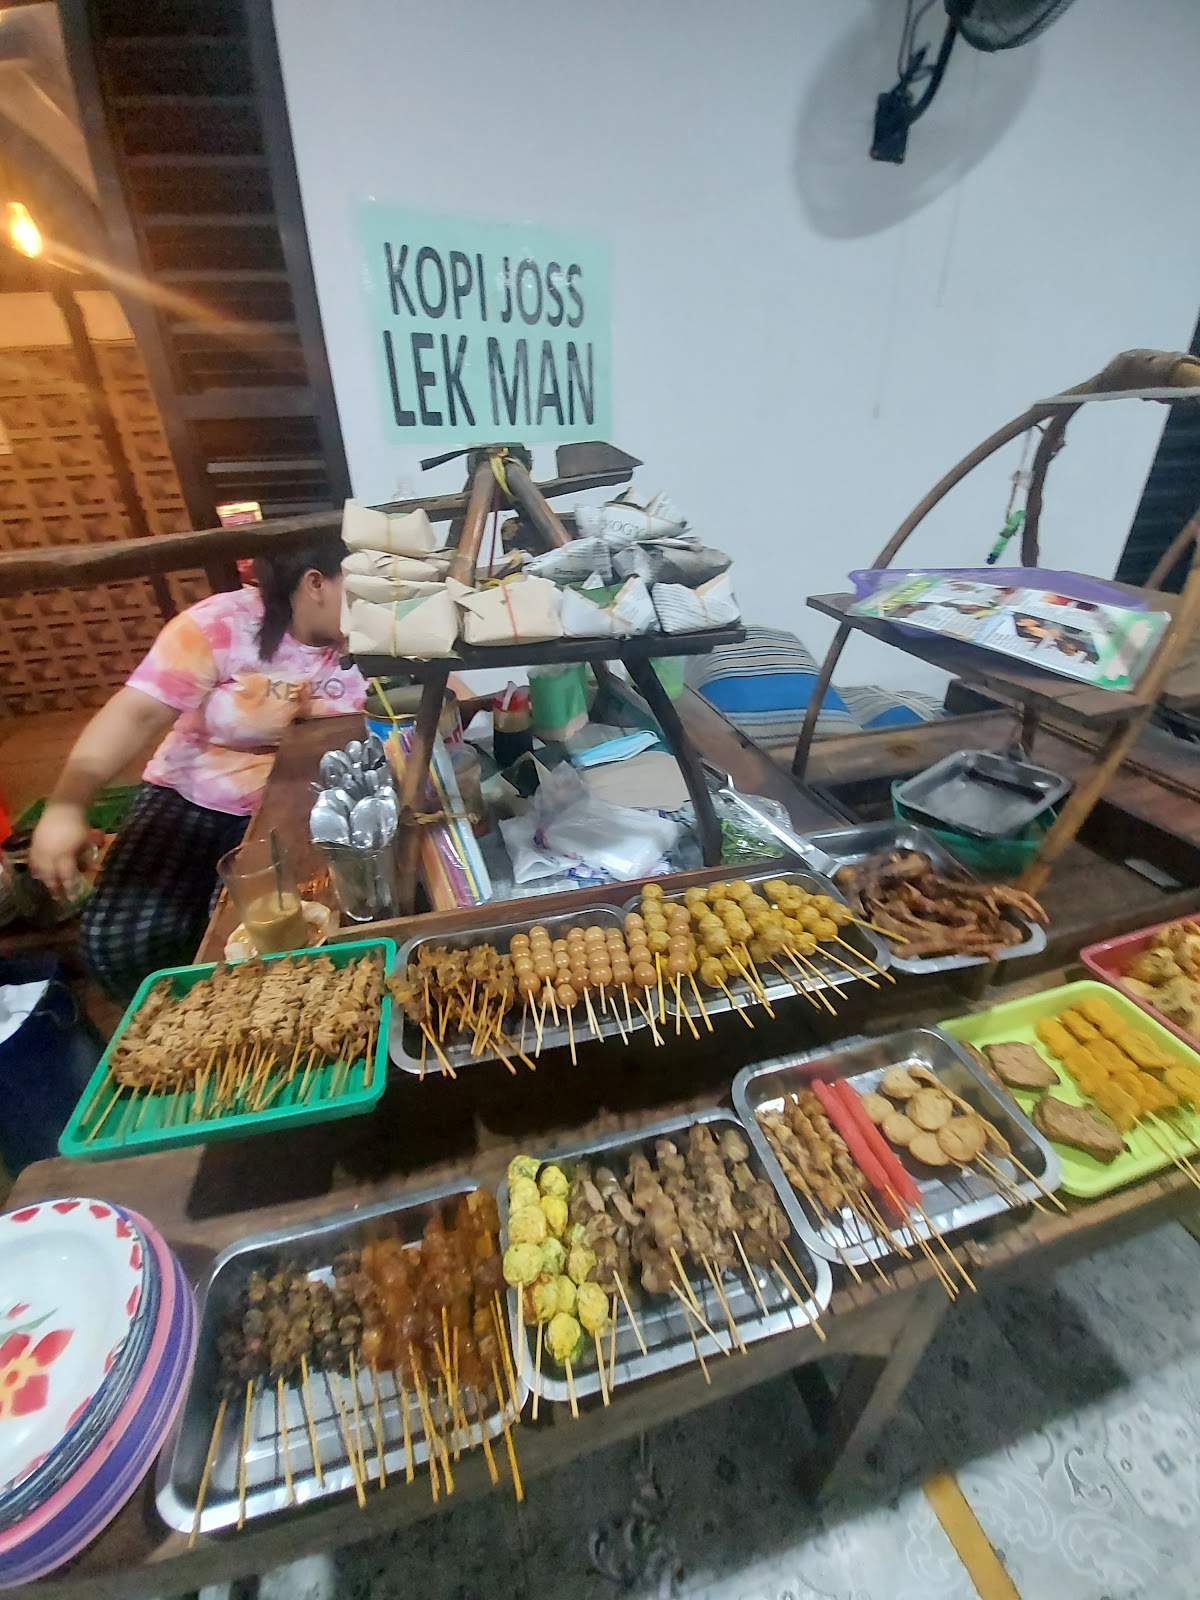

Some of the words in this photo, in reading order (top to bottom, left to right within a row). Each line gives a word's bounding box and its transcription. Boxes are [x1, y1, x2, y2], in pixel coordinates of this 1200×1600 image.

[384, 242, 487, 322] KOPI
[501, 256, 585, 328] JOSS
[384, 330, 476, 427] LEK
[487, 337, 594, 426] MAN
